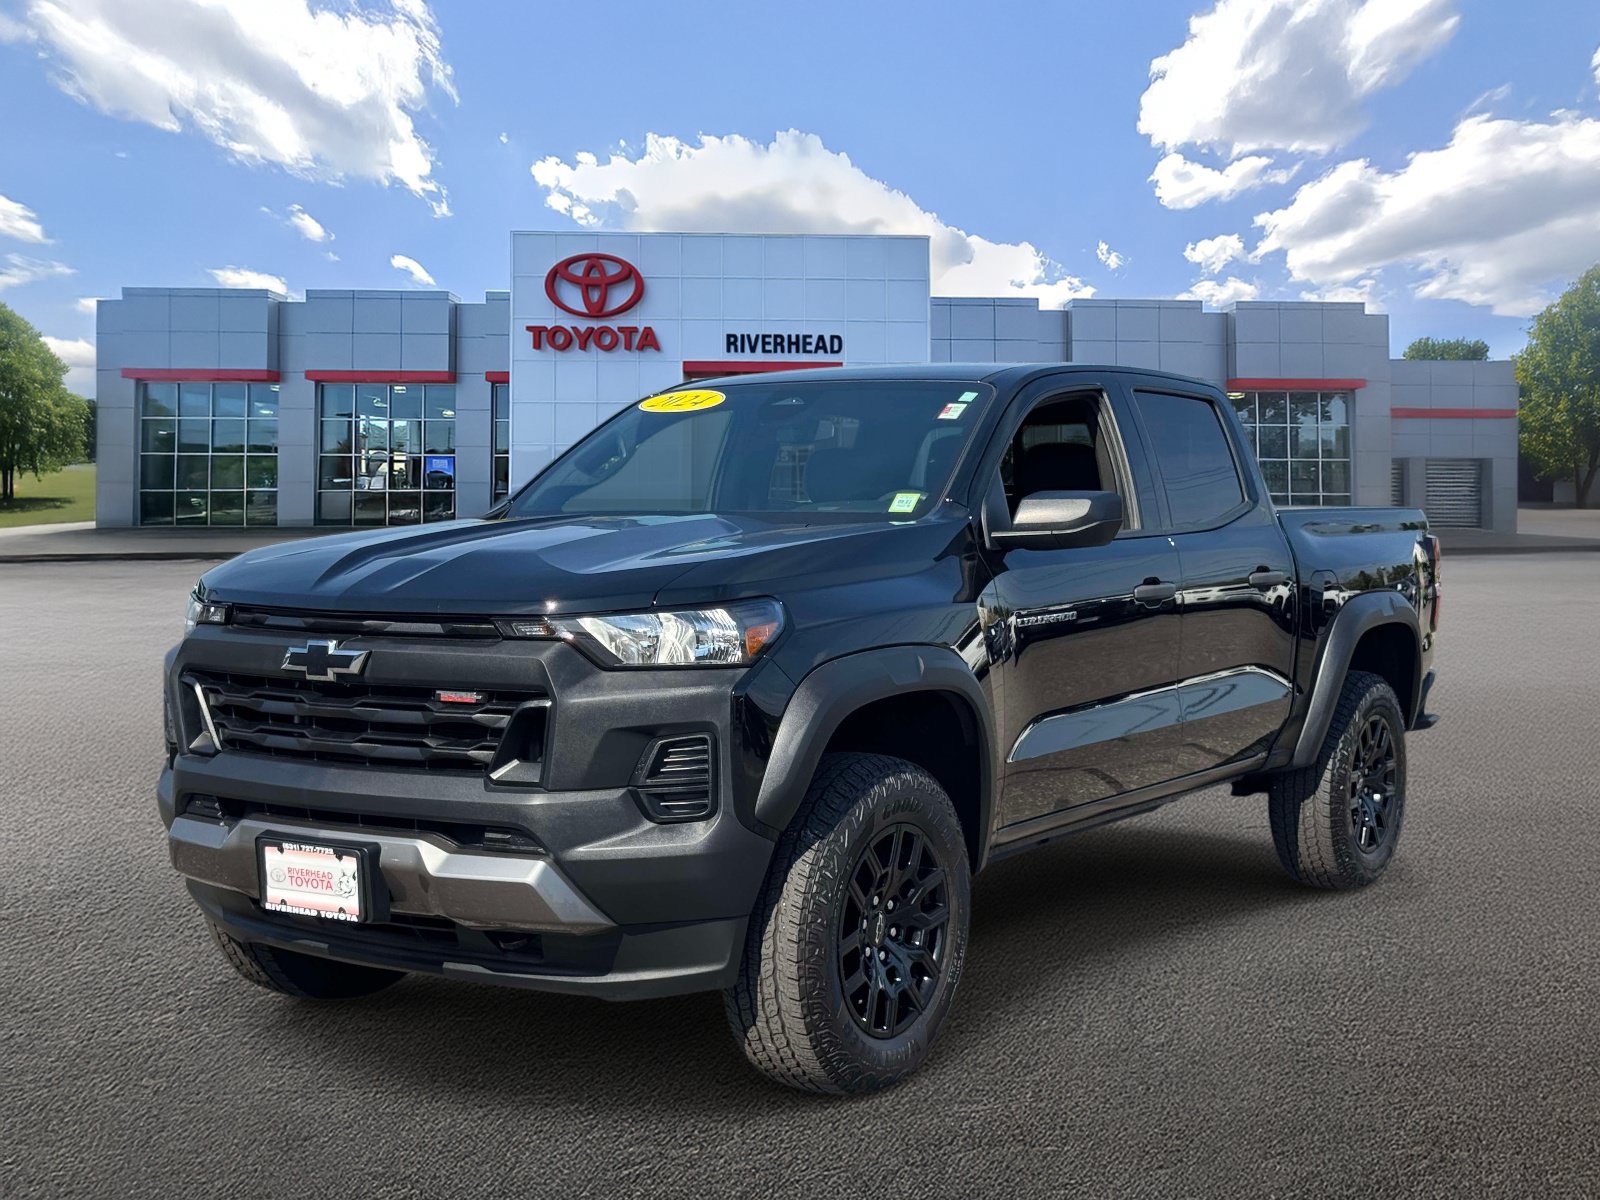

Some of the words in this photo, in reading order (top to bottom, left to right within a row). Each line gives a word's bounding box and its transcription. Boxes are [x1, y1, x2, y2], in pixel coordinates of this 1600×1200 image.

[526, 325, 660, 352] TOYOTA
[725, 333, 843, 355] RIVERHEAD
[287, 866, 333, 880] RIVERHEAD
[288, 875, 334, 891] TOYOTA
[265, 902, 318, 917] RIVERHEAD
[320, 910, 358, 922] TOYOTA
